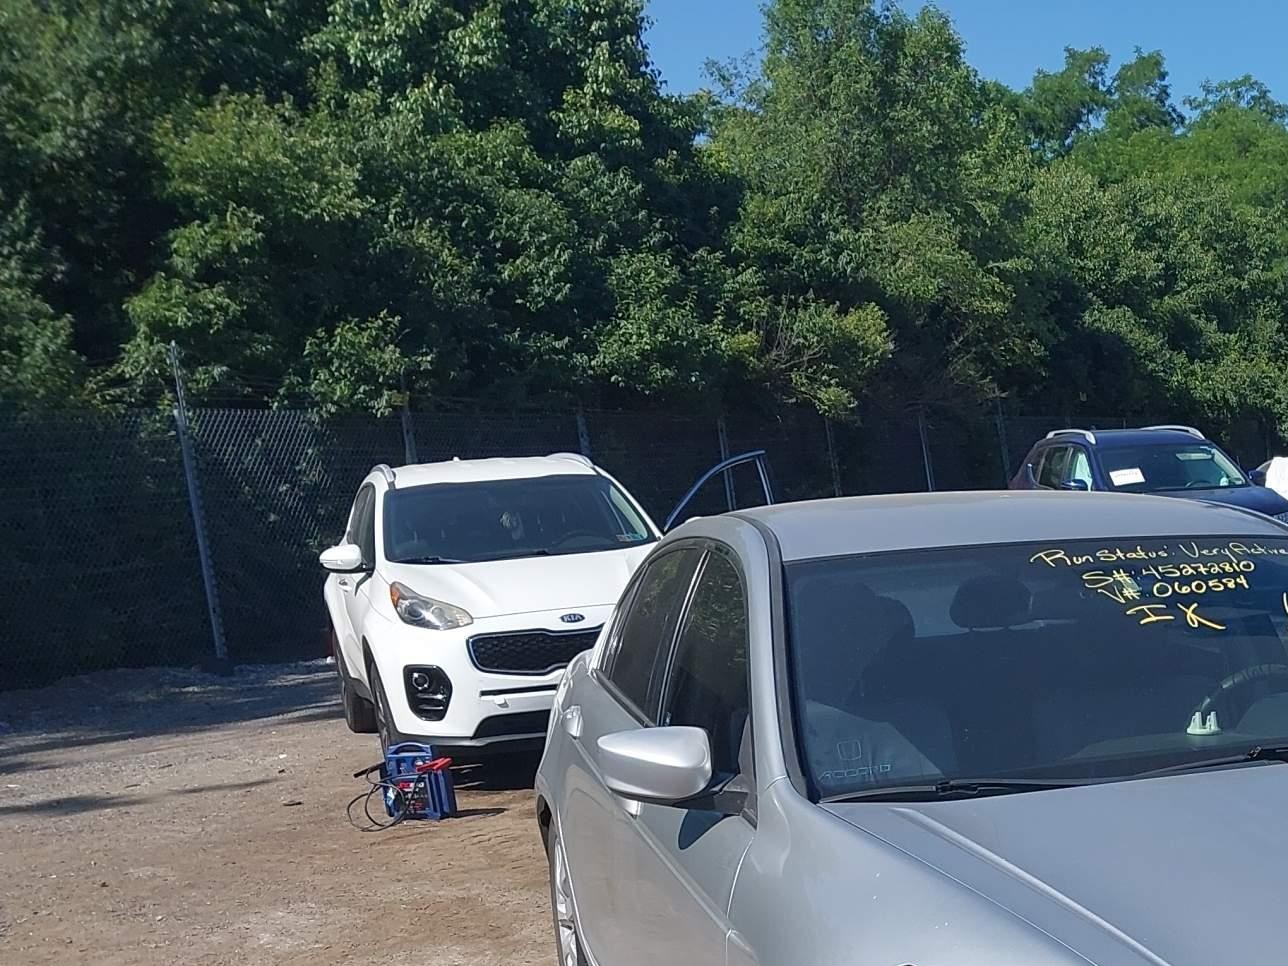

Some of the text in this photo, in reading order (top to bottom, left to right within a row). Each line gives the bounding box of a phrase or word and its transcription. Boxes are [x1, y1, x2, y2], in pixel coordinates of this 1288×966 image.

[1029, 548, 1094, 568] Run
[1142, 560, 1255, 580] 45272810
[1152, 574, 1250, 598] 060584
[563, 613, 583, 622] KIA
